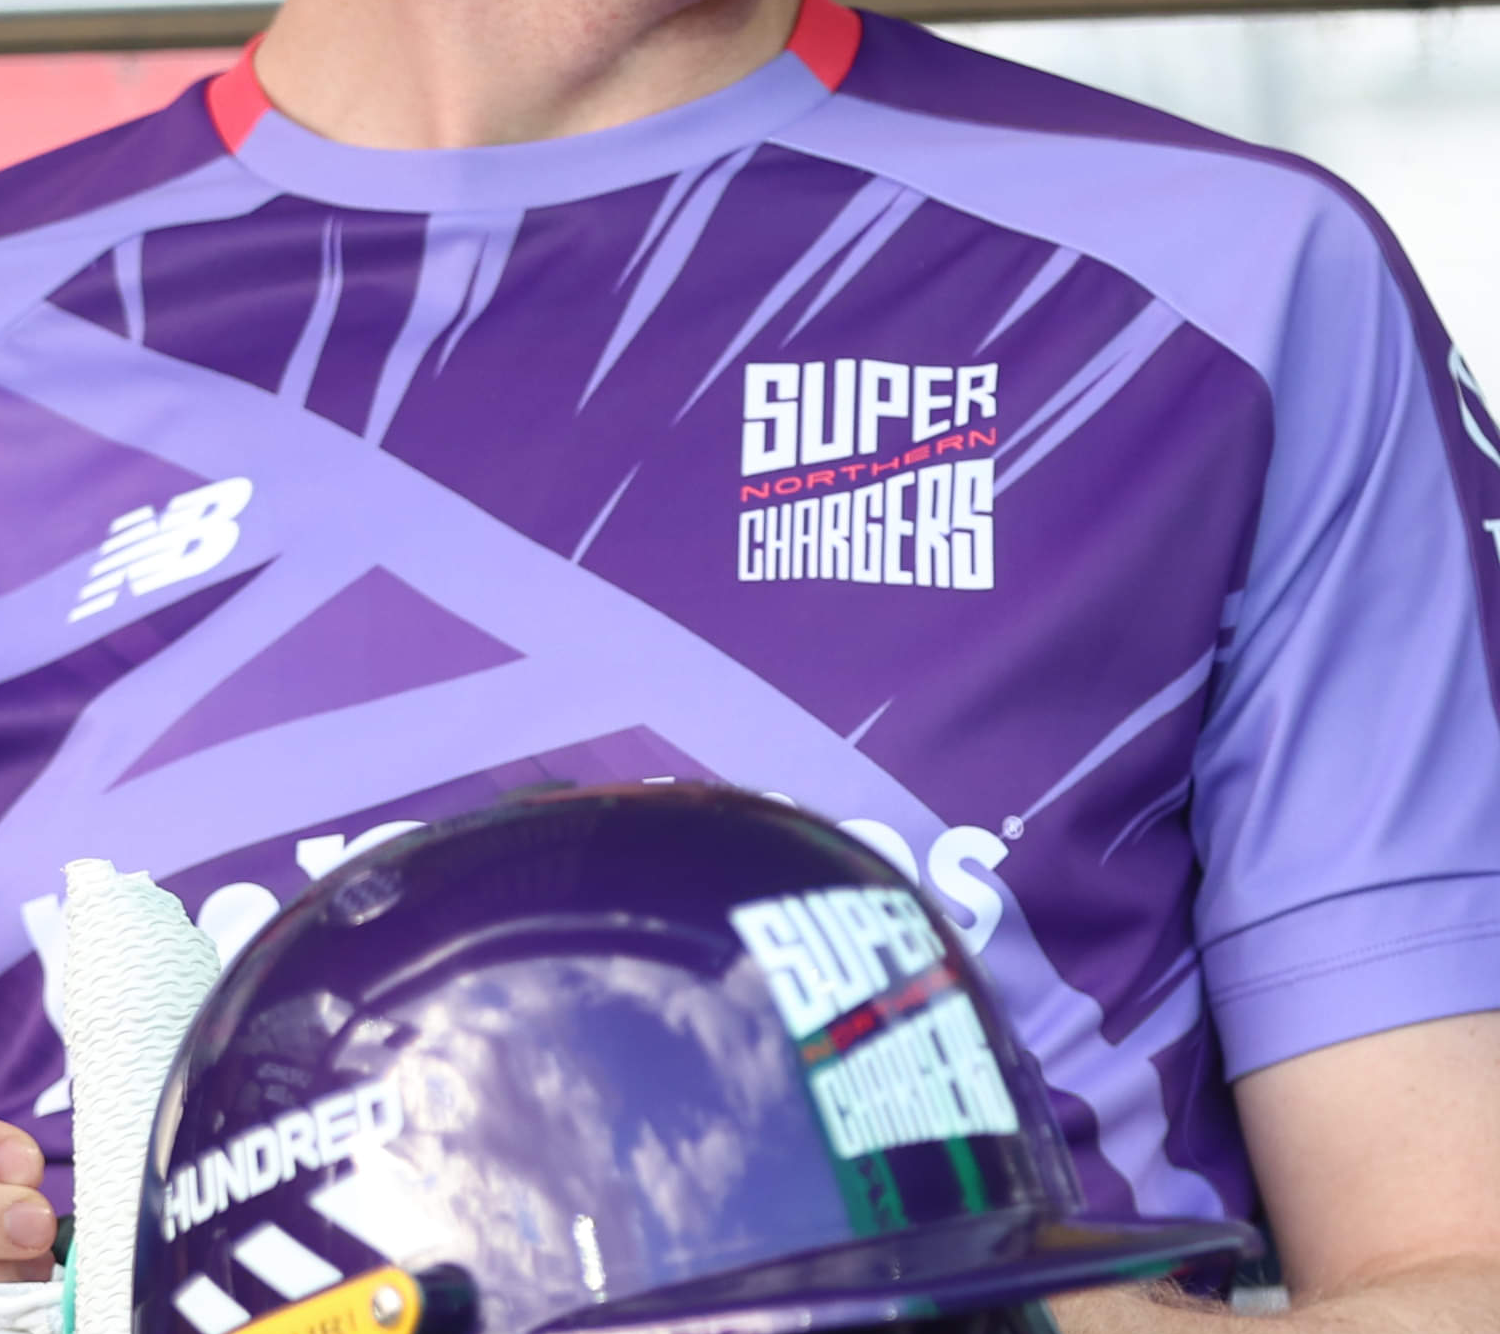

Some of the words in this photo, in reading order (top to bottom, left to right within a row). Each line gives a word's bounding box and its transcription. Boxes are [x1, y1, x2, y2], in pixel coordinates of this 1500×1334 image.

[740, 427, 998, 503] NORTHERN
[741, 358, 999, 477] SUPER
[737, 457, 995, 591] CHARGERS
